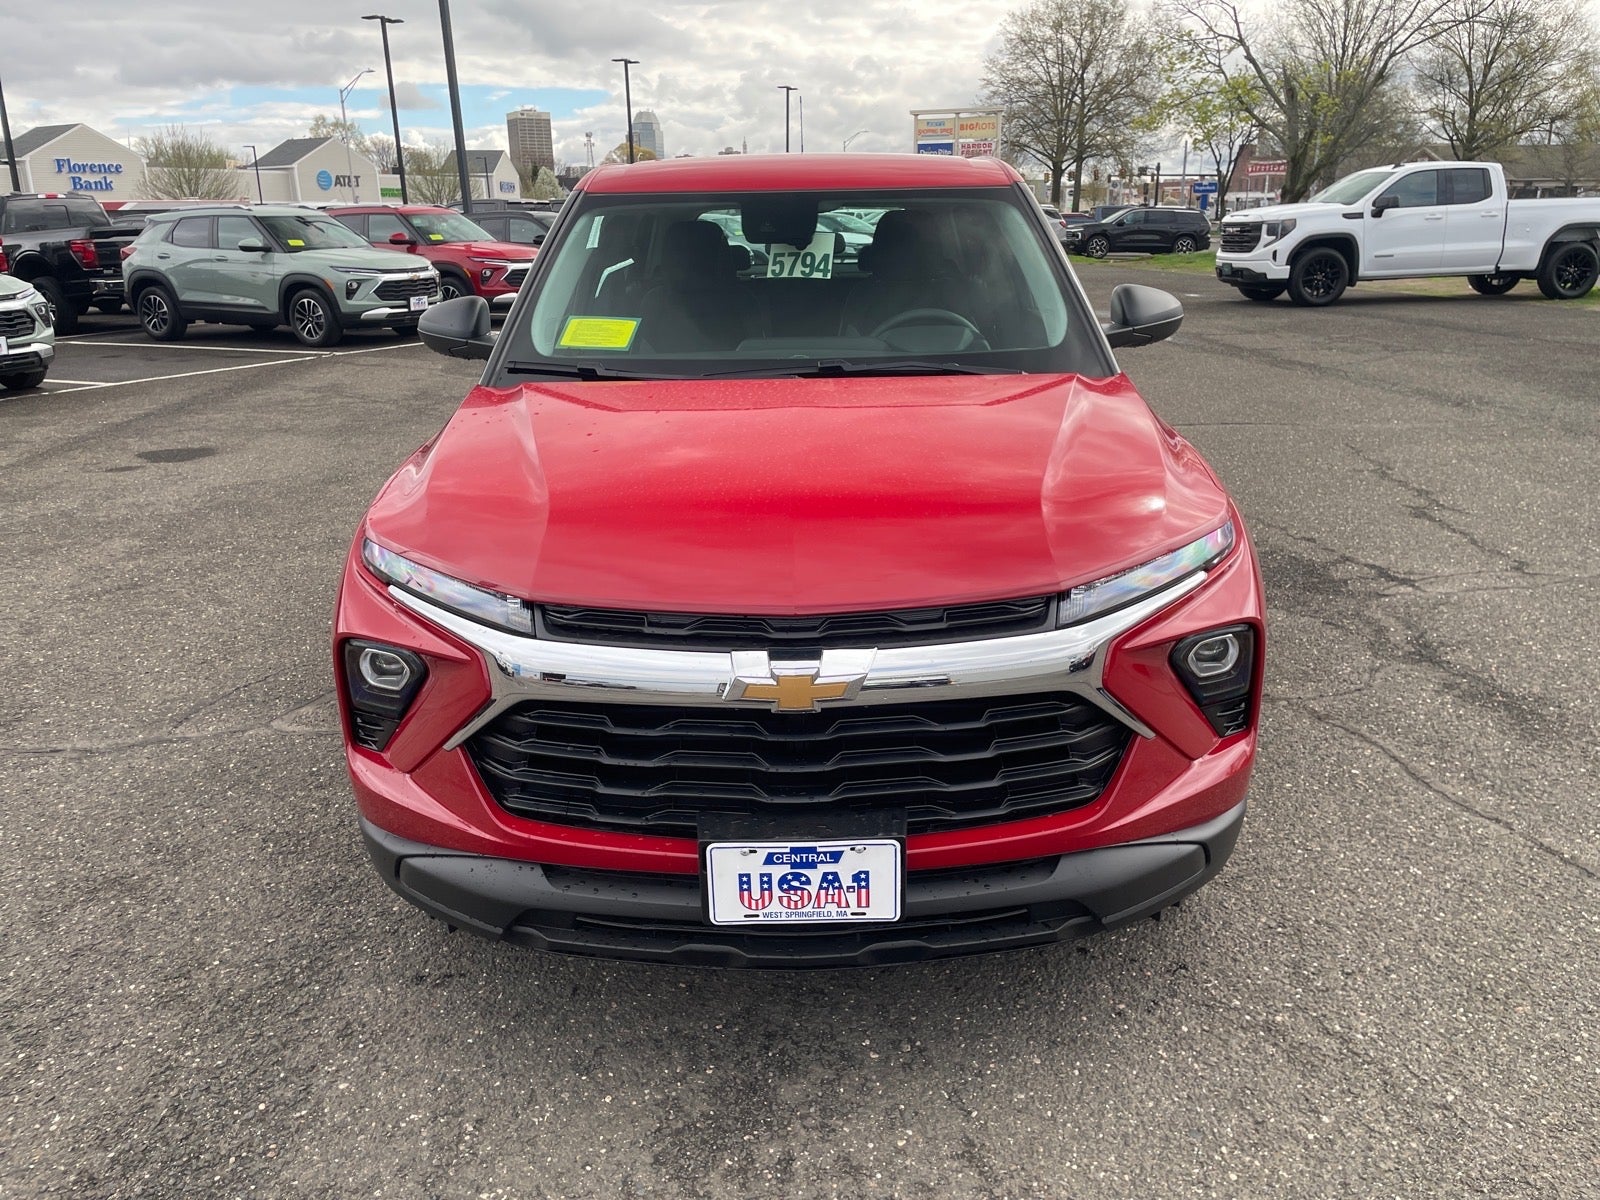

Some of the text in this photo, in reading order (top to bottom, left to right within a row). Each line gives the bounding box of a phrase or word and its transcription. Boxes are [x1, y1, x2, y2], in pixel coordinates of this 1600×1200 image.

[55, 158, 123, 174] Florence
[70, 175, 114, 191] Bank
[334, 175, 360, 187] AT&T
[770, 252, 831, 278] 5794
[773, 853, 835, 863] CENTRAL
[737, 870, 870, 911] USA-1
[762, 911, 784, 919] WEST
[785, 911, 835, 919] SPRINGFIELD,
